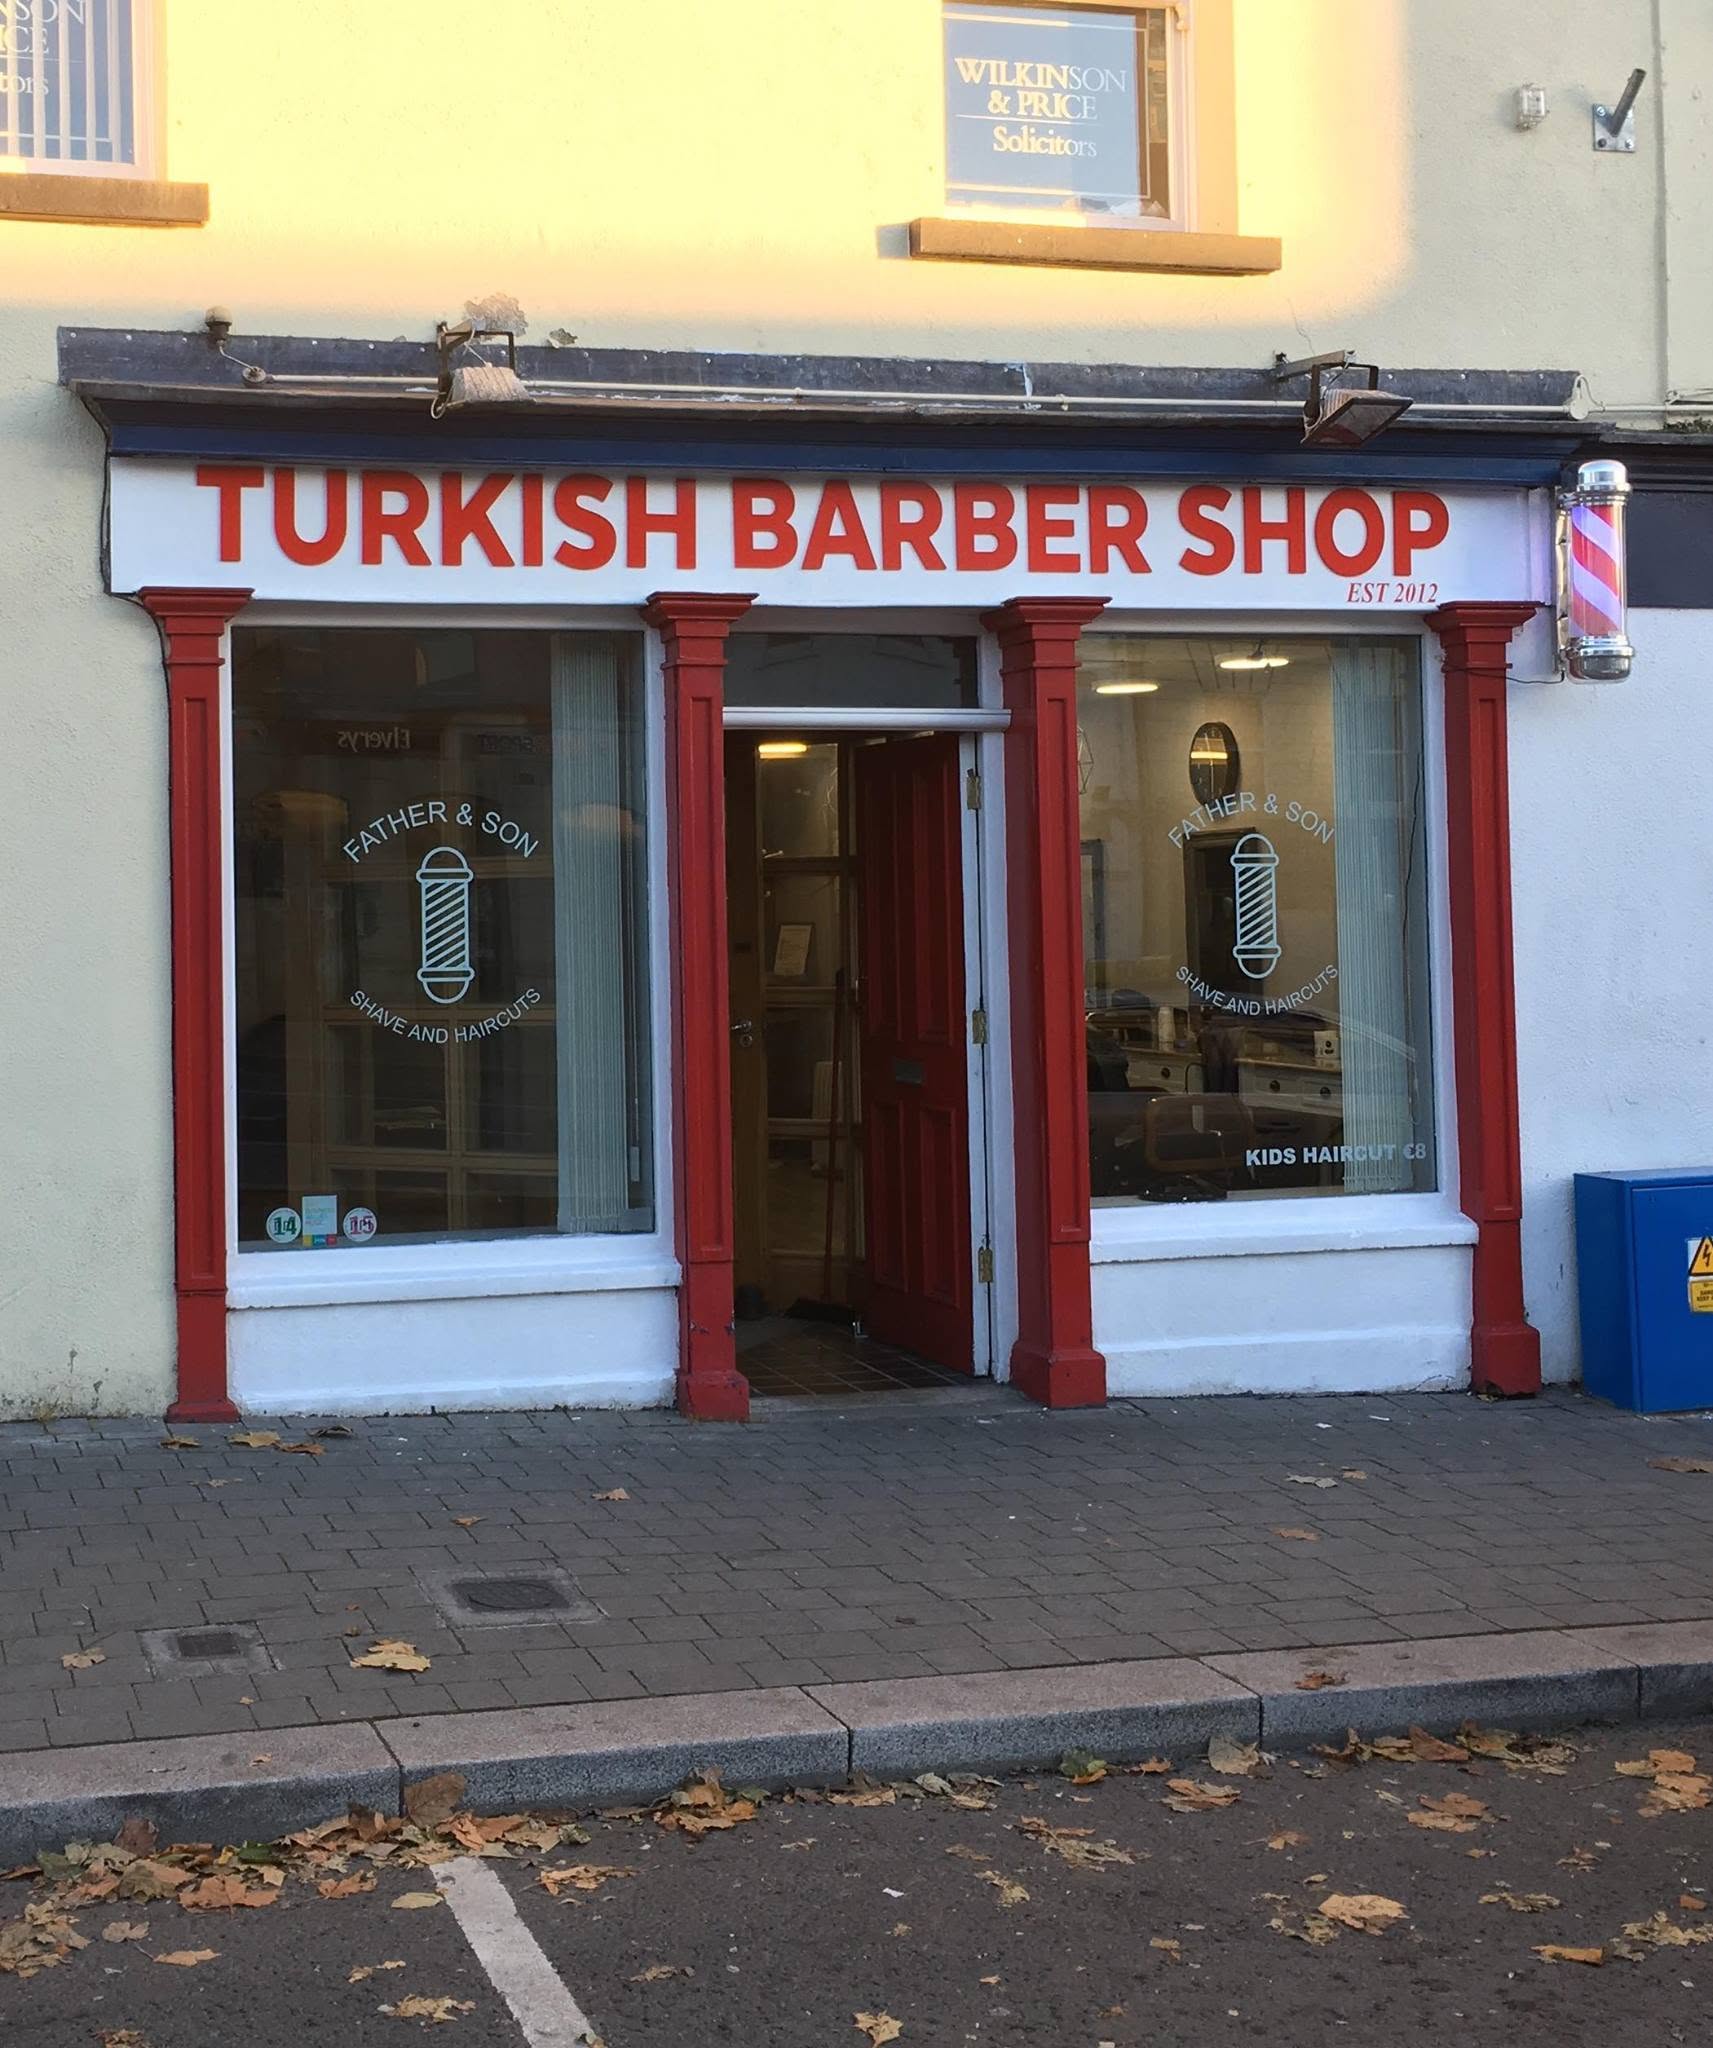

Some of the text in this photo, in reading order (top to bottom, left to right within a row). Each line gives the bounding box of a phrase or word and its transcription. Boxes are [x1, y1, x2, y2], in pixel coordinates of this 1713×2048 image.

[954, 57, 1127, 93] WILKINSON
[987, 90, 1098, 120] & PRICE
[993, 125, 1097, 157] Solicitors
[196, 464, 1449, 577] TURKISH BARBER SHOP
[1347, 582, 1438, 604] EST 2012
[343, 801, 539, 863] FATHER & SON
[1168, 792, 1335, 848] FATHER & SON
[1176, 964, 1338, 1016] SHAVE AND HAIRCUTS
[350, 988, 541, 1044] SHAVE AND HAIRCUTS
[1246, 1147, 1296, 1166] KIDS
[1303, 1143, 1396, 1164] HAIRCUT
